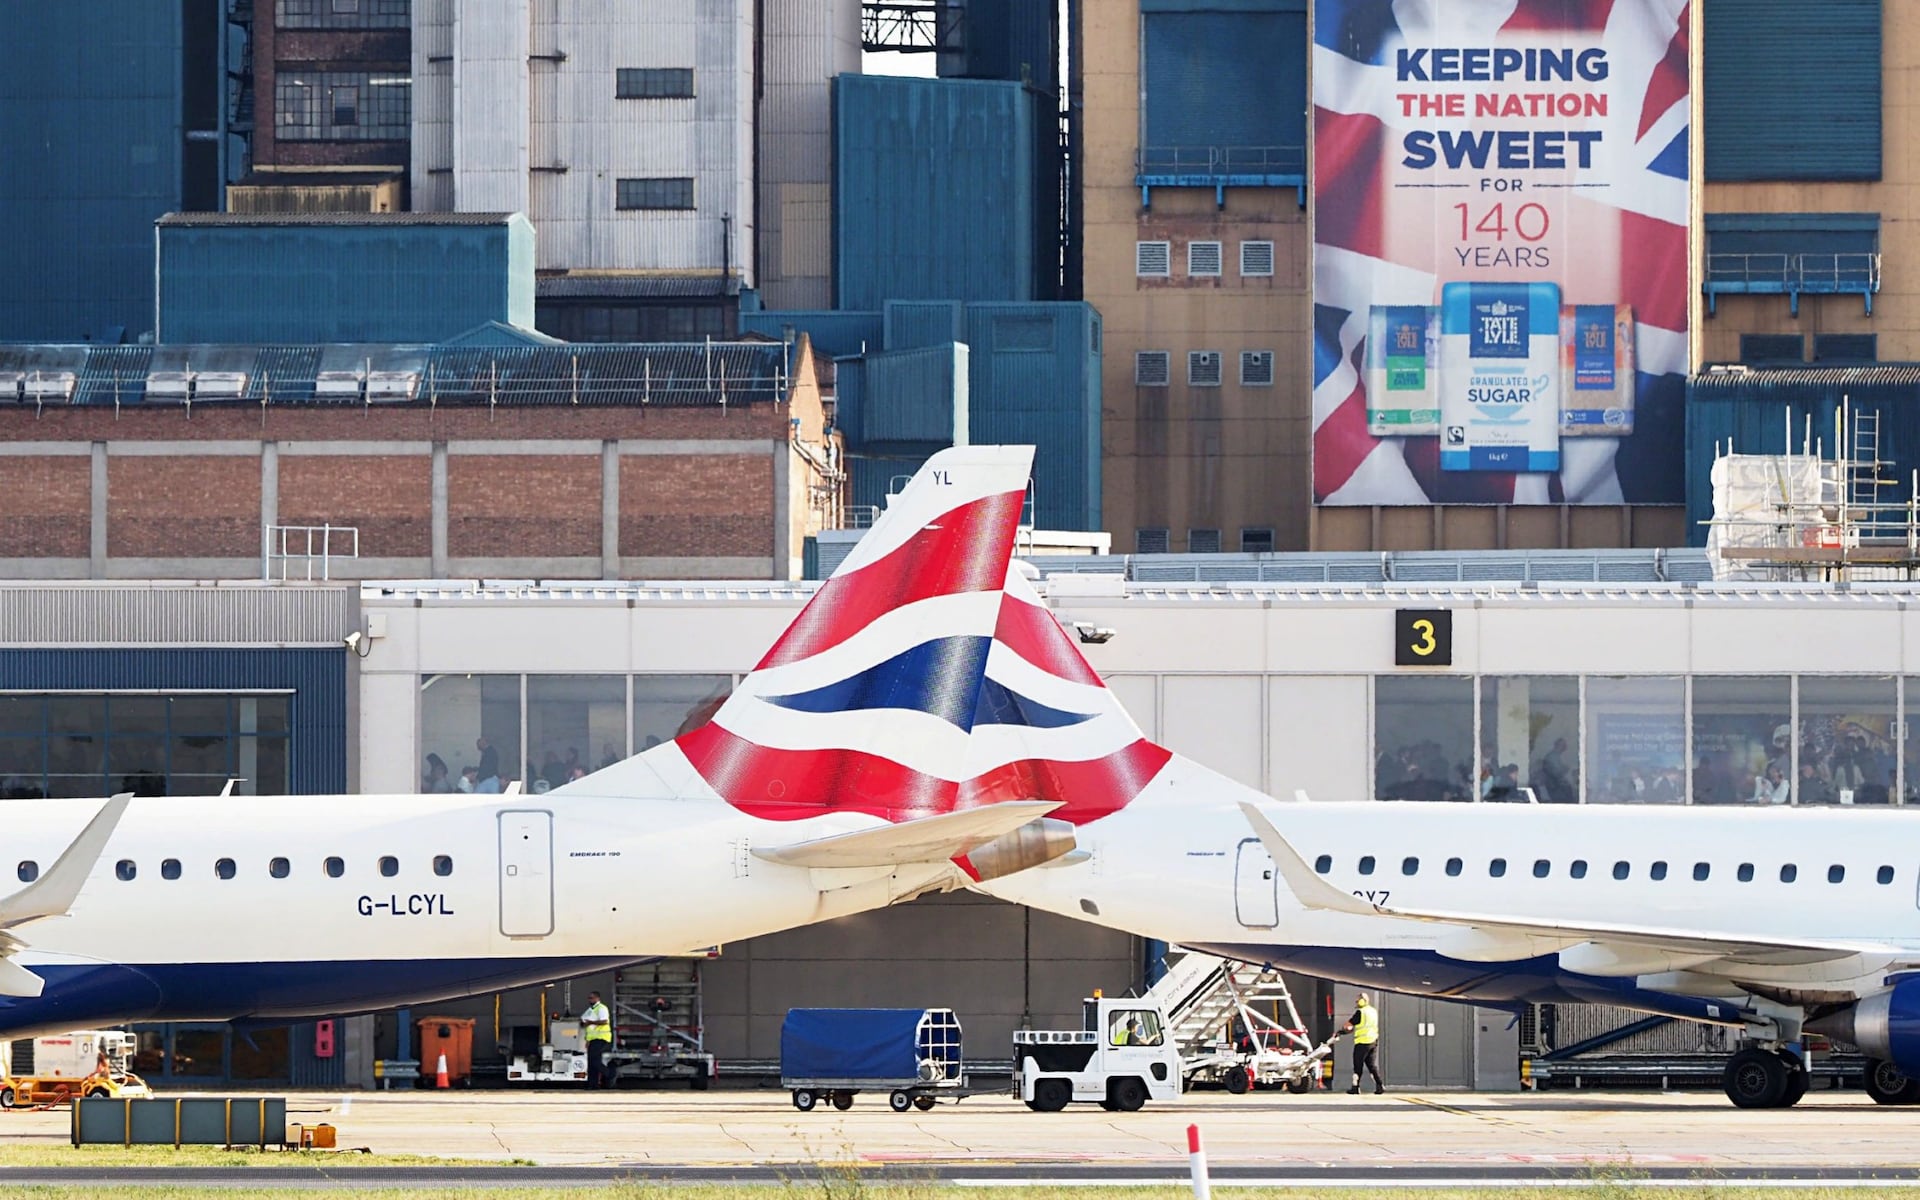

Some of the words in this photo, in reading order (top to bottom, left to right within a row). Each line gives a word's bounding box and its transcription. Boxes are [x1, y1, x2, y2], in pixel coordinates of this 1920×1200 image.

[1396, 48, 1609, 82] KEEPING
[1396, 94, 1465, 117] THE
[1475, 93, 1608, 117] NATION
[1401, 131, 1602, 169] SWEET
[1480, 178, 1523, 192] FOR
[1453, 202, 1550, 242] 140
[1454, 247, 1550, 268] YEARS
[1481, 317, 1518, 330] TATE
[1484, 329, 1518, 344] LYLE
[1470, 377, 1528, 386] GRANULATED
[1468, 388, 1530, 403] SUGAR
[933, 470, 953, 486] YL
[1410, 619, 1437, 656] 3
[357, 893, 455, 917] G-LCYL
